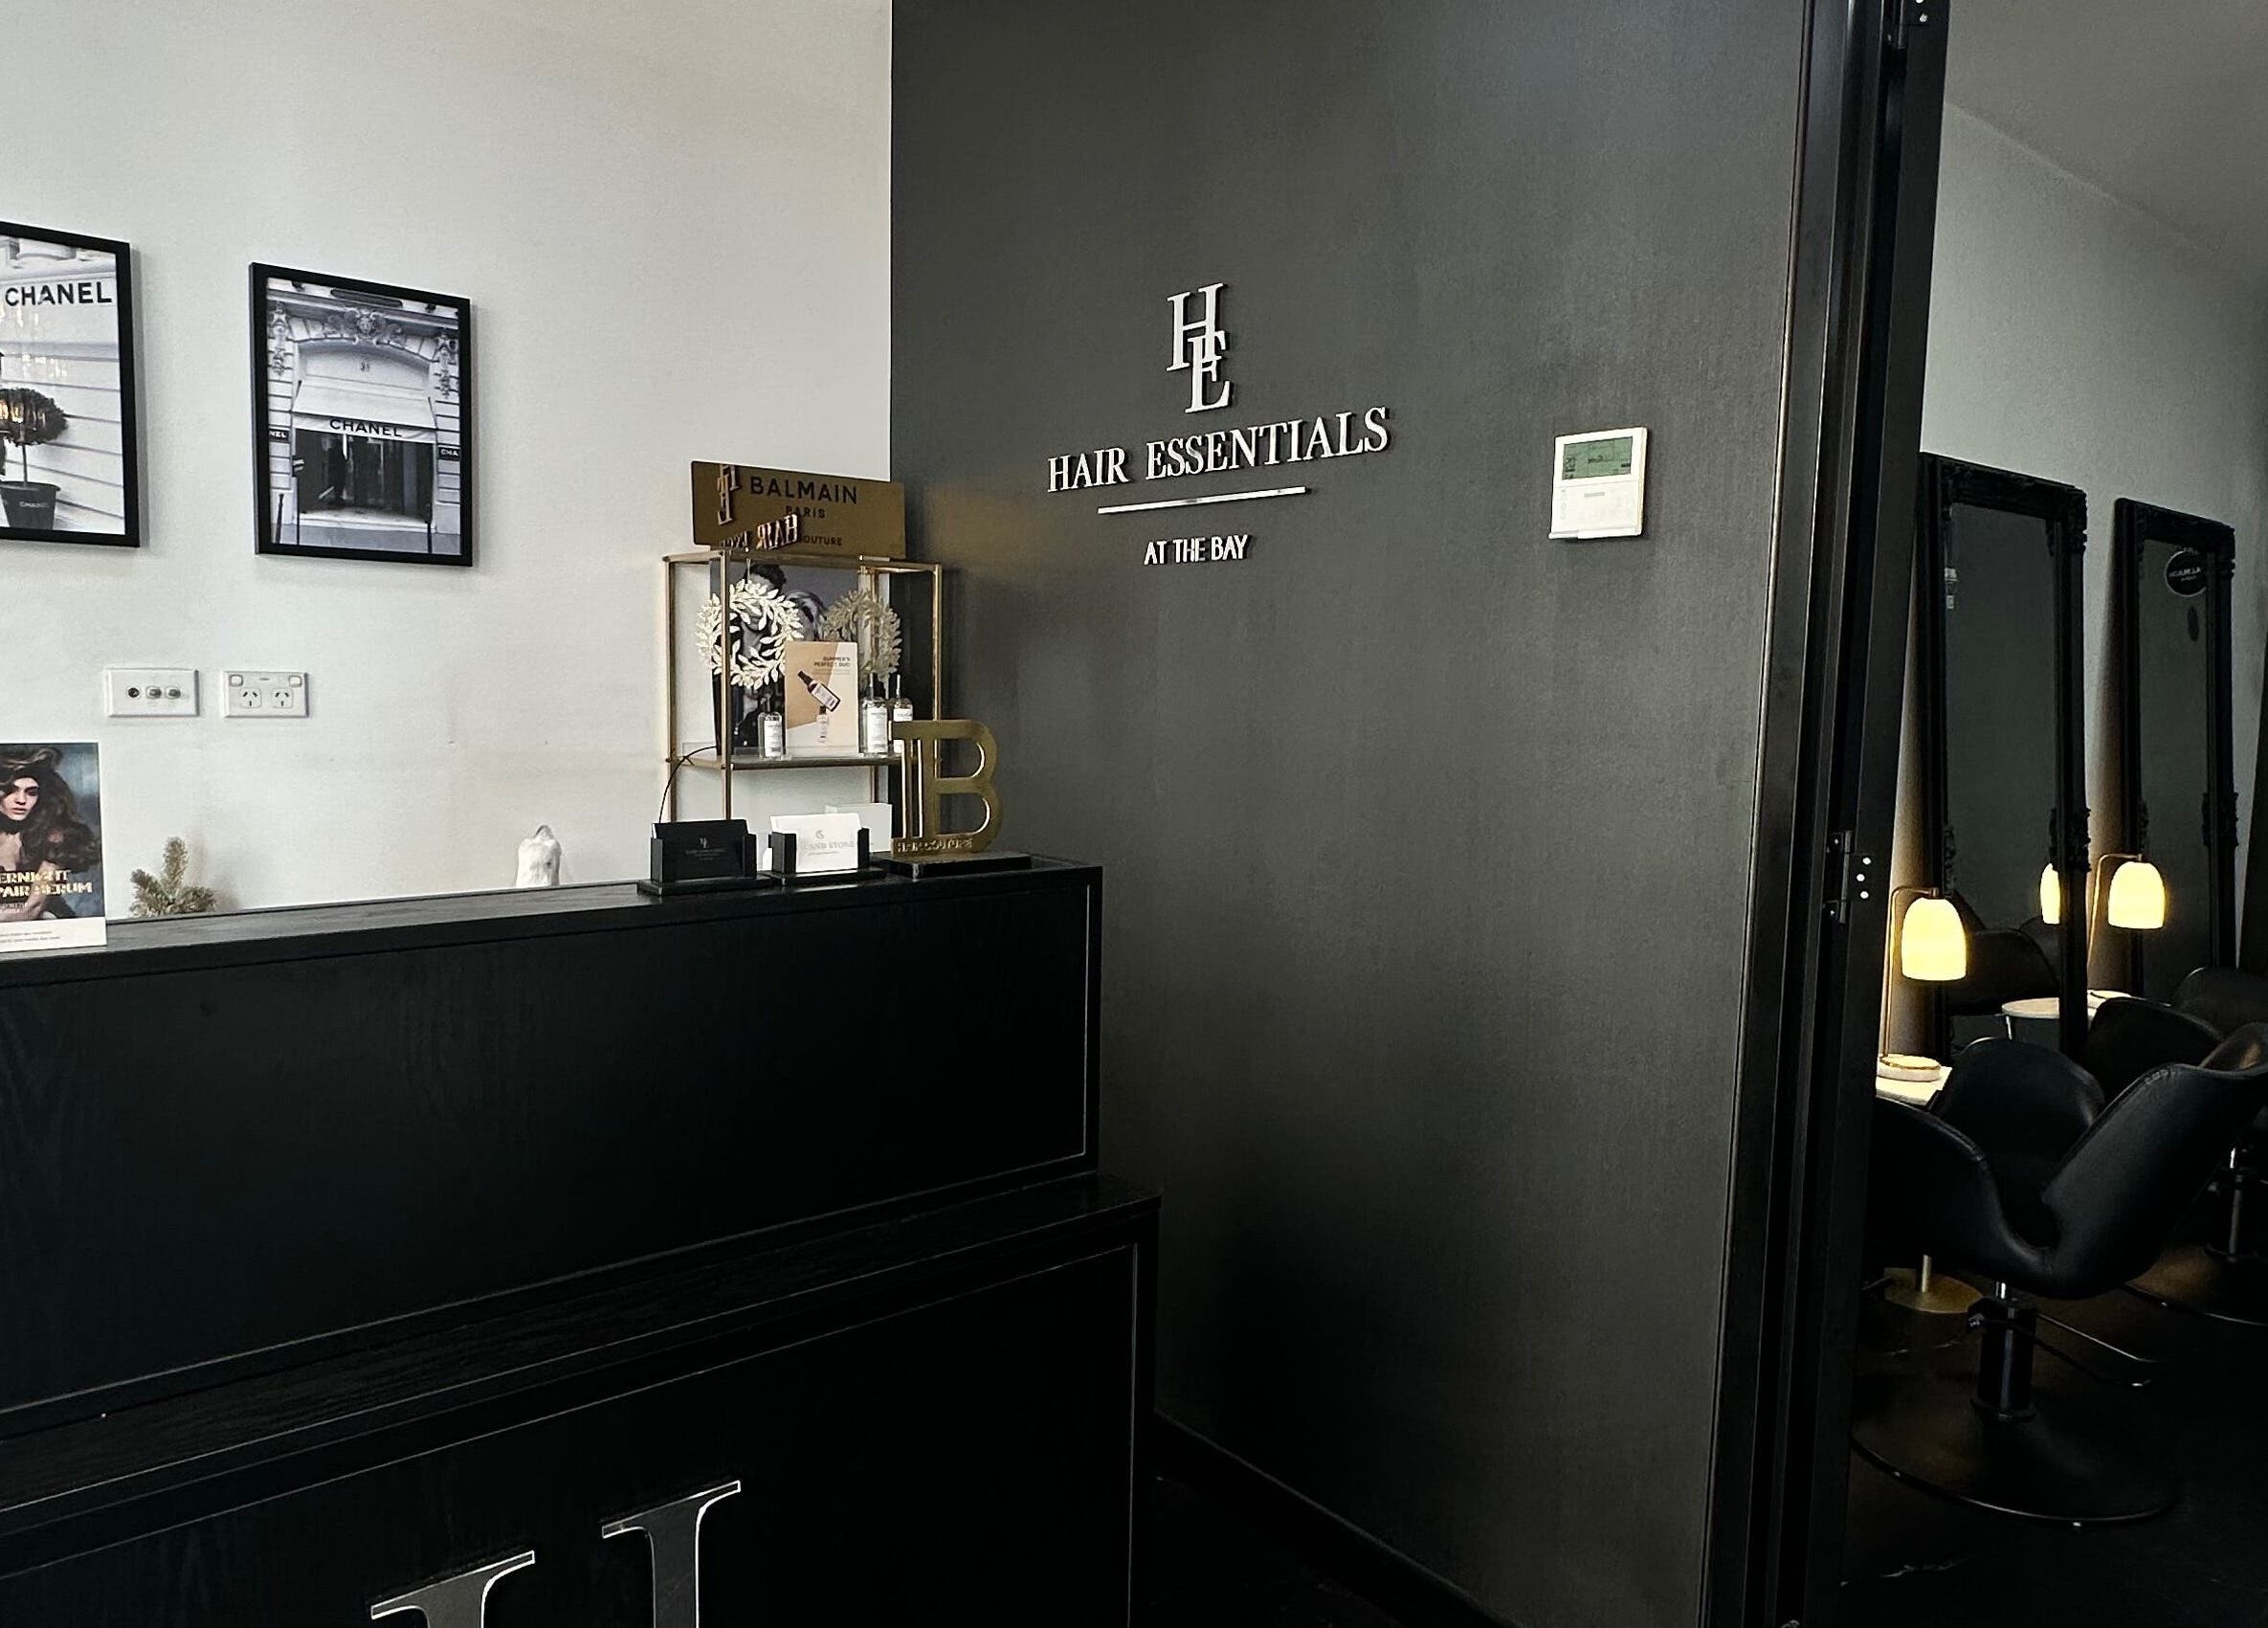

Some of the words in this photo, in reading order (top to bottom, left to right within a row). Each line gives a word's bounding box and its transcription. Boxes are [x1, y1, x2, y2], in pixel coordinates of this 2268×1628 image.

[5, 281, 113, 306] CHANEL
[329, 418, 403, 437] CHANEL
[1047, 446, 1129, 493] HAIR
[1145, 406, 1390, 480] ESSENTIALS
[750, 476, 857, 504] BALMAIN
[798, 535, 843, 547] OUTURE
[1144, 541, 1167, 566] AT
[1172, 537, 1206, 563] THE
[1212, 534, 1248, 561] BAY
